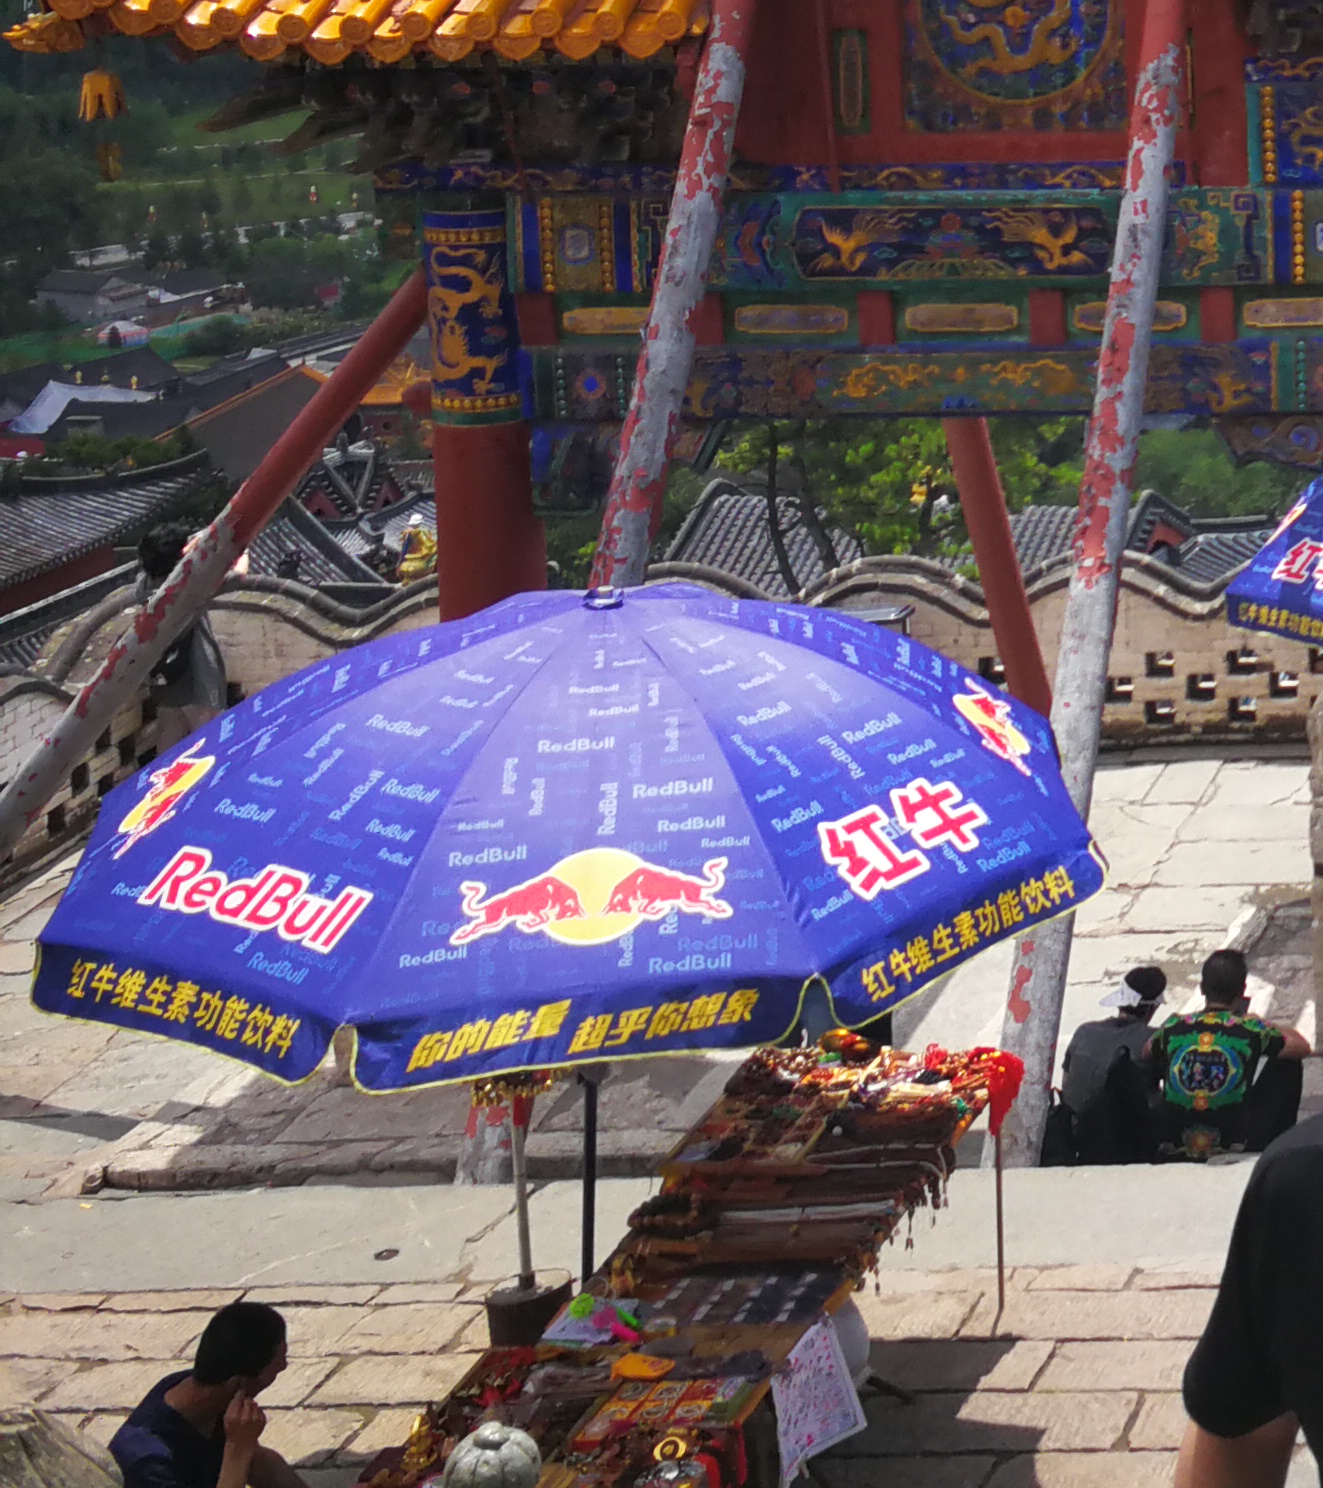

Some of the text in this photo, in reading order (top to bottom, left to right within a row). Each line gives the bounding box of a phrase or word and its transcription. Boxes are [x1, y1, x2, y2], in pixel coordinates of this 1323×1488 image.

[569, 683, 619, 694] RedBull
[589, 704, 639, 717] RedBull
[737, 701, 791, 727] RedBull
[366, 714, 430, 737] RedBull
[841, 712, 902, 744] RedBull
[538, 736, 615, 753] RedBull
[887, 738, 937, 765] RedBull
[817, 735, 865, 780] RedBull
[381, 778, 440, 803] RedBull
[633, 777, 713, 799] RedBull
[214, 798, 276, 823] RedBull
[597, 782, 618, 836] RedBull
[771, 800, 824, 832] RedBull
[365, 818, 416, 842] RedBull
[457, 819, 504, 831] RedBull
[658, 815, 726, 833] RedBull
[701, 836, 750, 848] RedBull
[819, 779, 987, 900] 红牛
[449, 845, 527, 867] RedBull
[976, 840, 1032, 872] RedBull
[139, 846, 372, 953] RedBull
[861, 865, 1076, 1002] 红牛维生素功能饮料
[248, 951, 309, 985] RedBull
[400, 946, 468, 968] RedBull
[649, 952, 732, 974] RedBull
[67, 957, 302, 1059] 红牛维生素功能饮料
[406, 988, 761, 1073] 你的能量 超乎你想象
